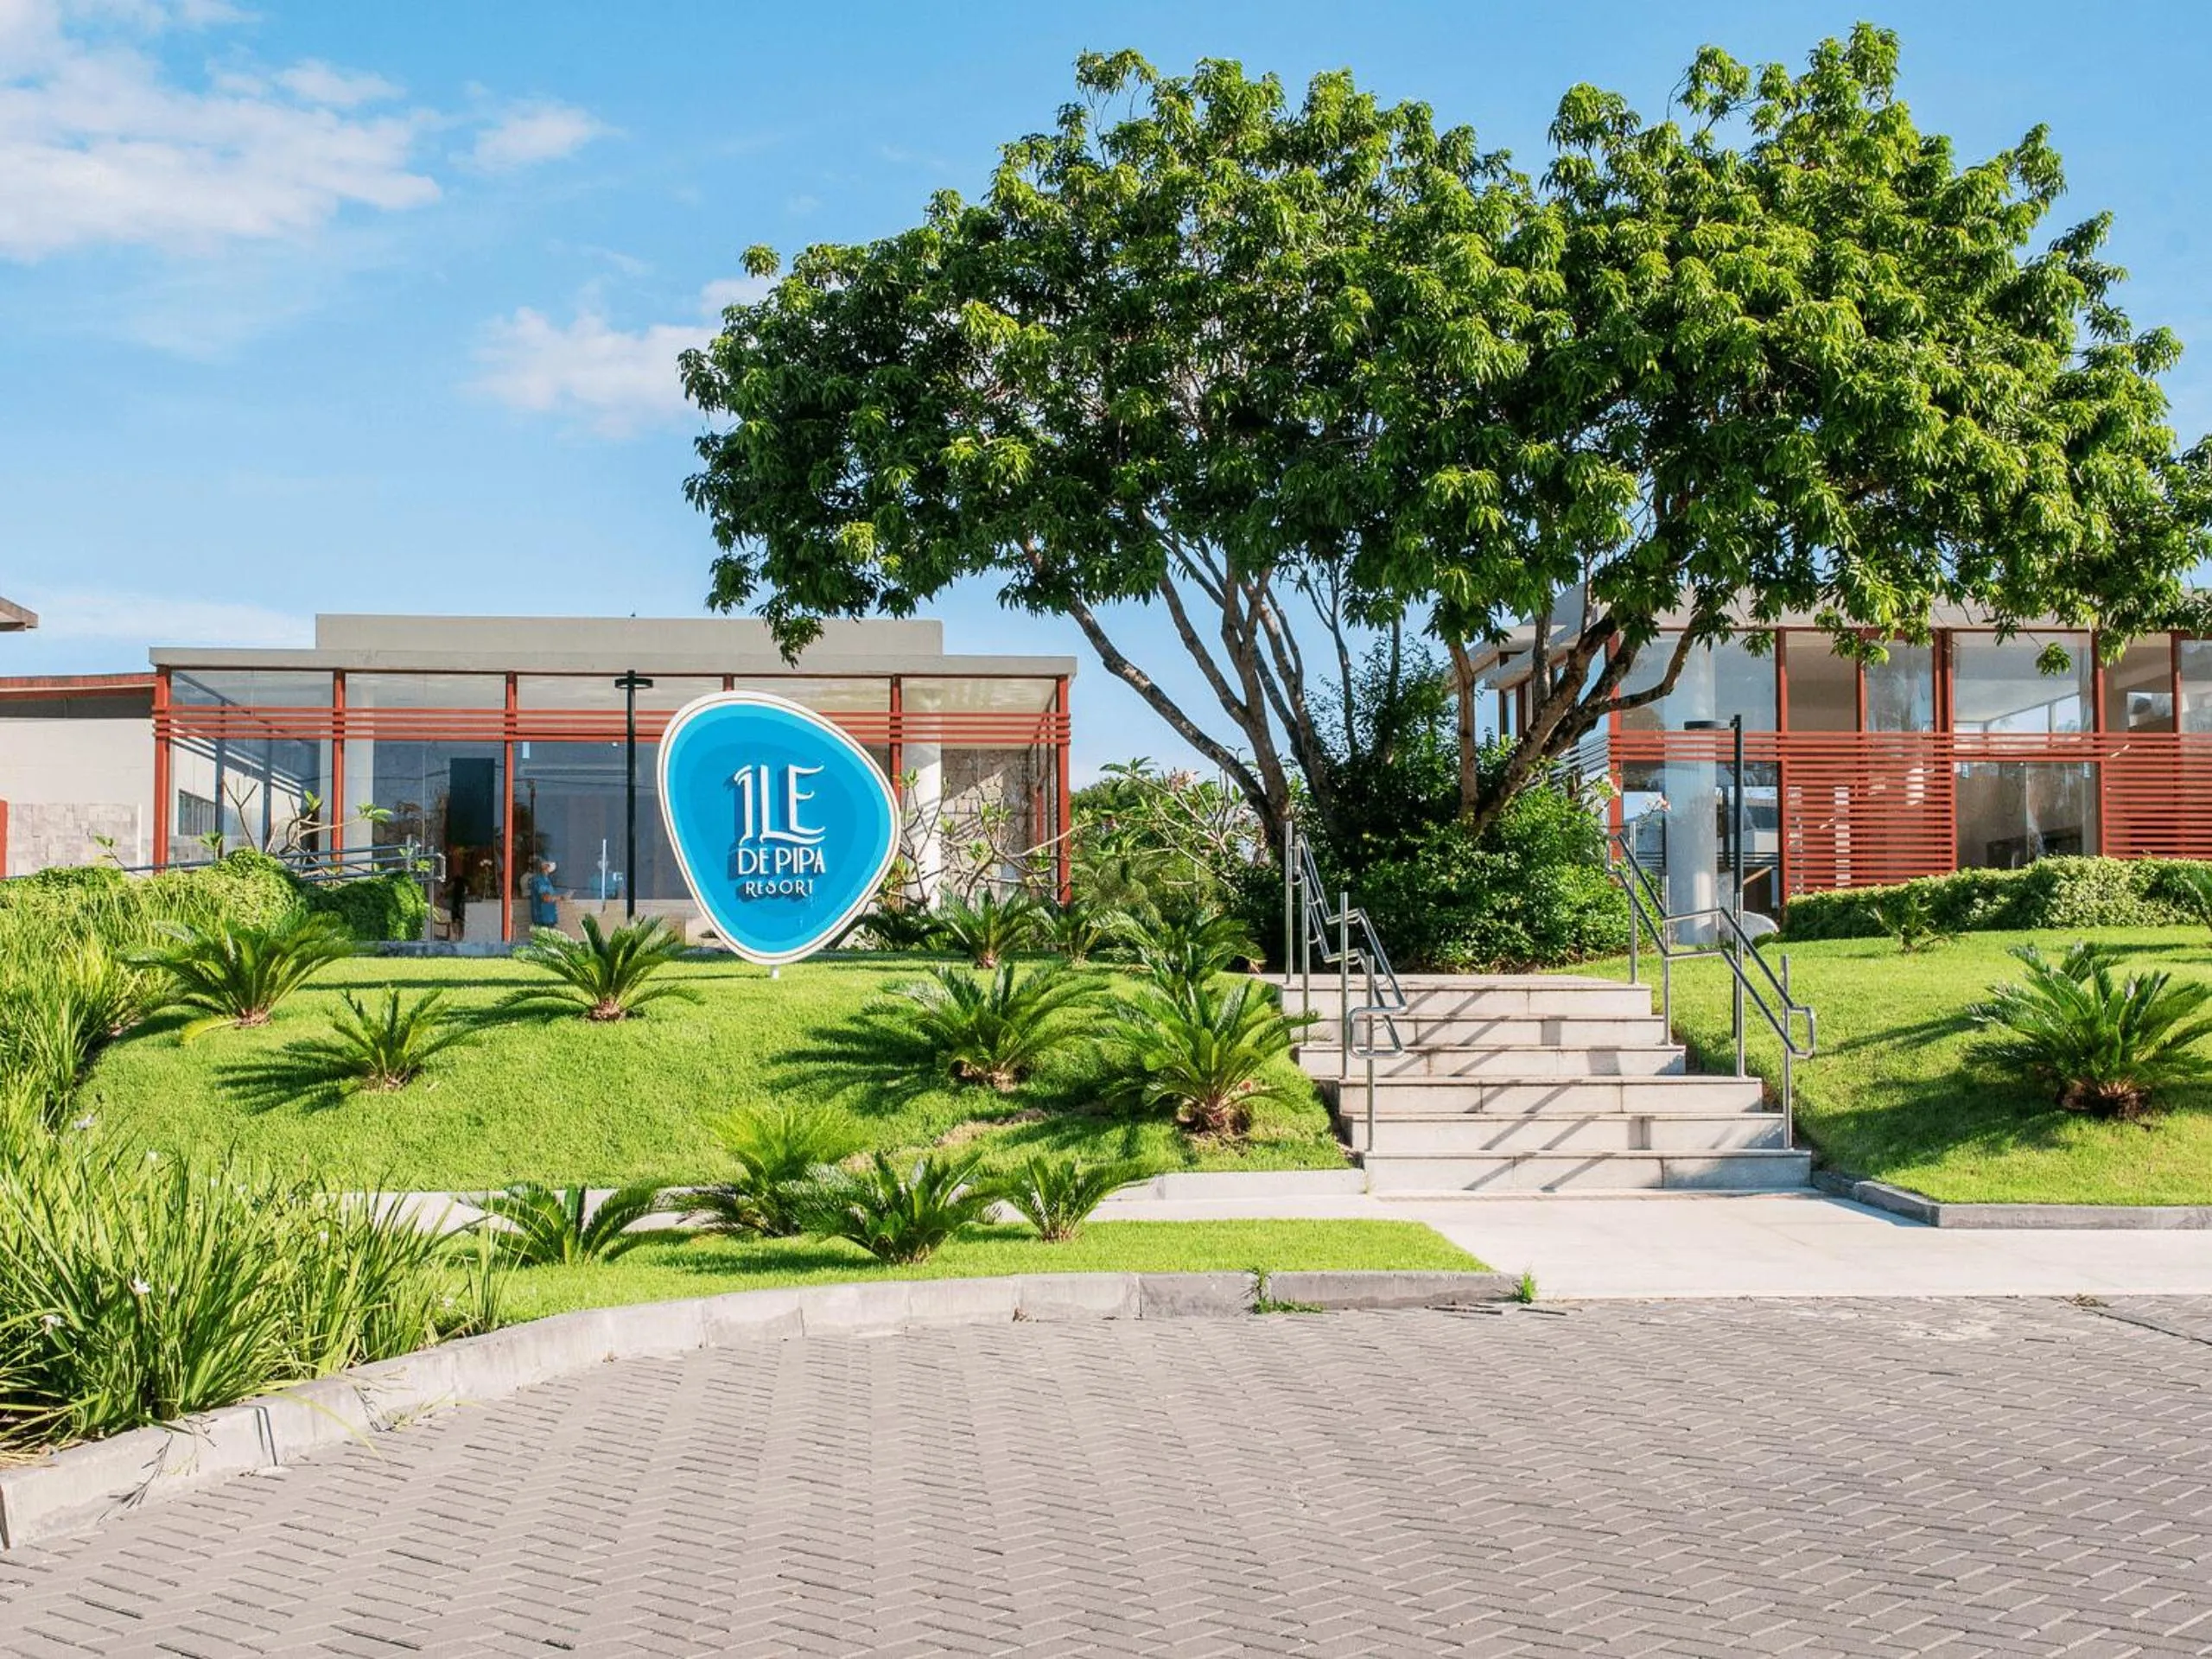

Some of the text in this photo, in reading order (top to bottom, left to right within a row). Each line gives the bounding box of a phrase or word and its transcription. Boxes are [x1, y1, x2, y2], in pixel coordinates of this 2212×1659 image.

[738, 848, 826, 874] DE PIPA
[746, 880, 814, 897] RESORT
